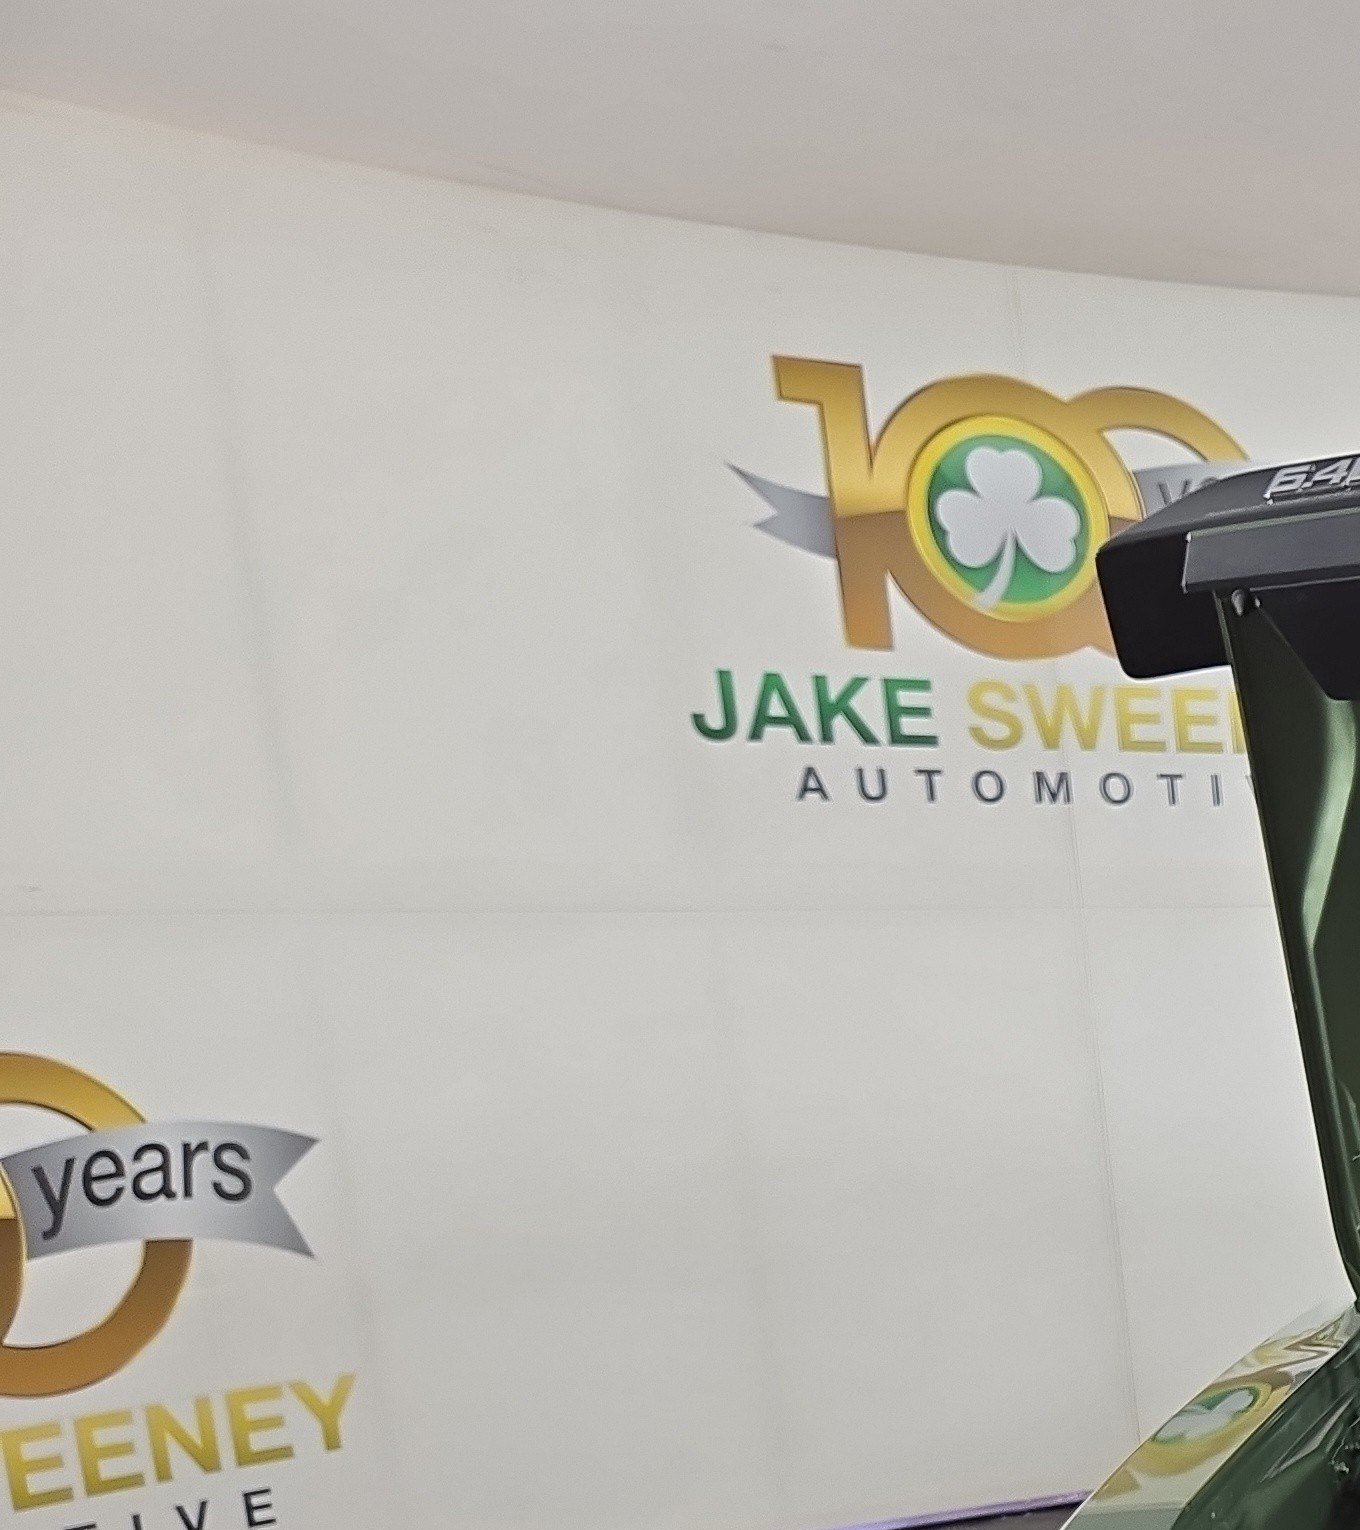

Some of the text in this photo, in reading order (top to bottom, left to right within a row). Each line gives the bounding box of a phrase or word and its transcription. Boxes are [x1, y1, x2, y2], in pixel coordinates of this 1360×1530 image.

[691, 669, 940, 747] JAKE
[797, 767, 1256, 806] AUTOMOTI
[31, 1139, 253, 1240] years
